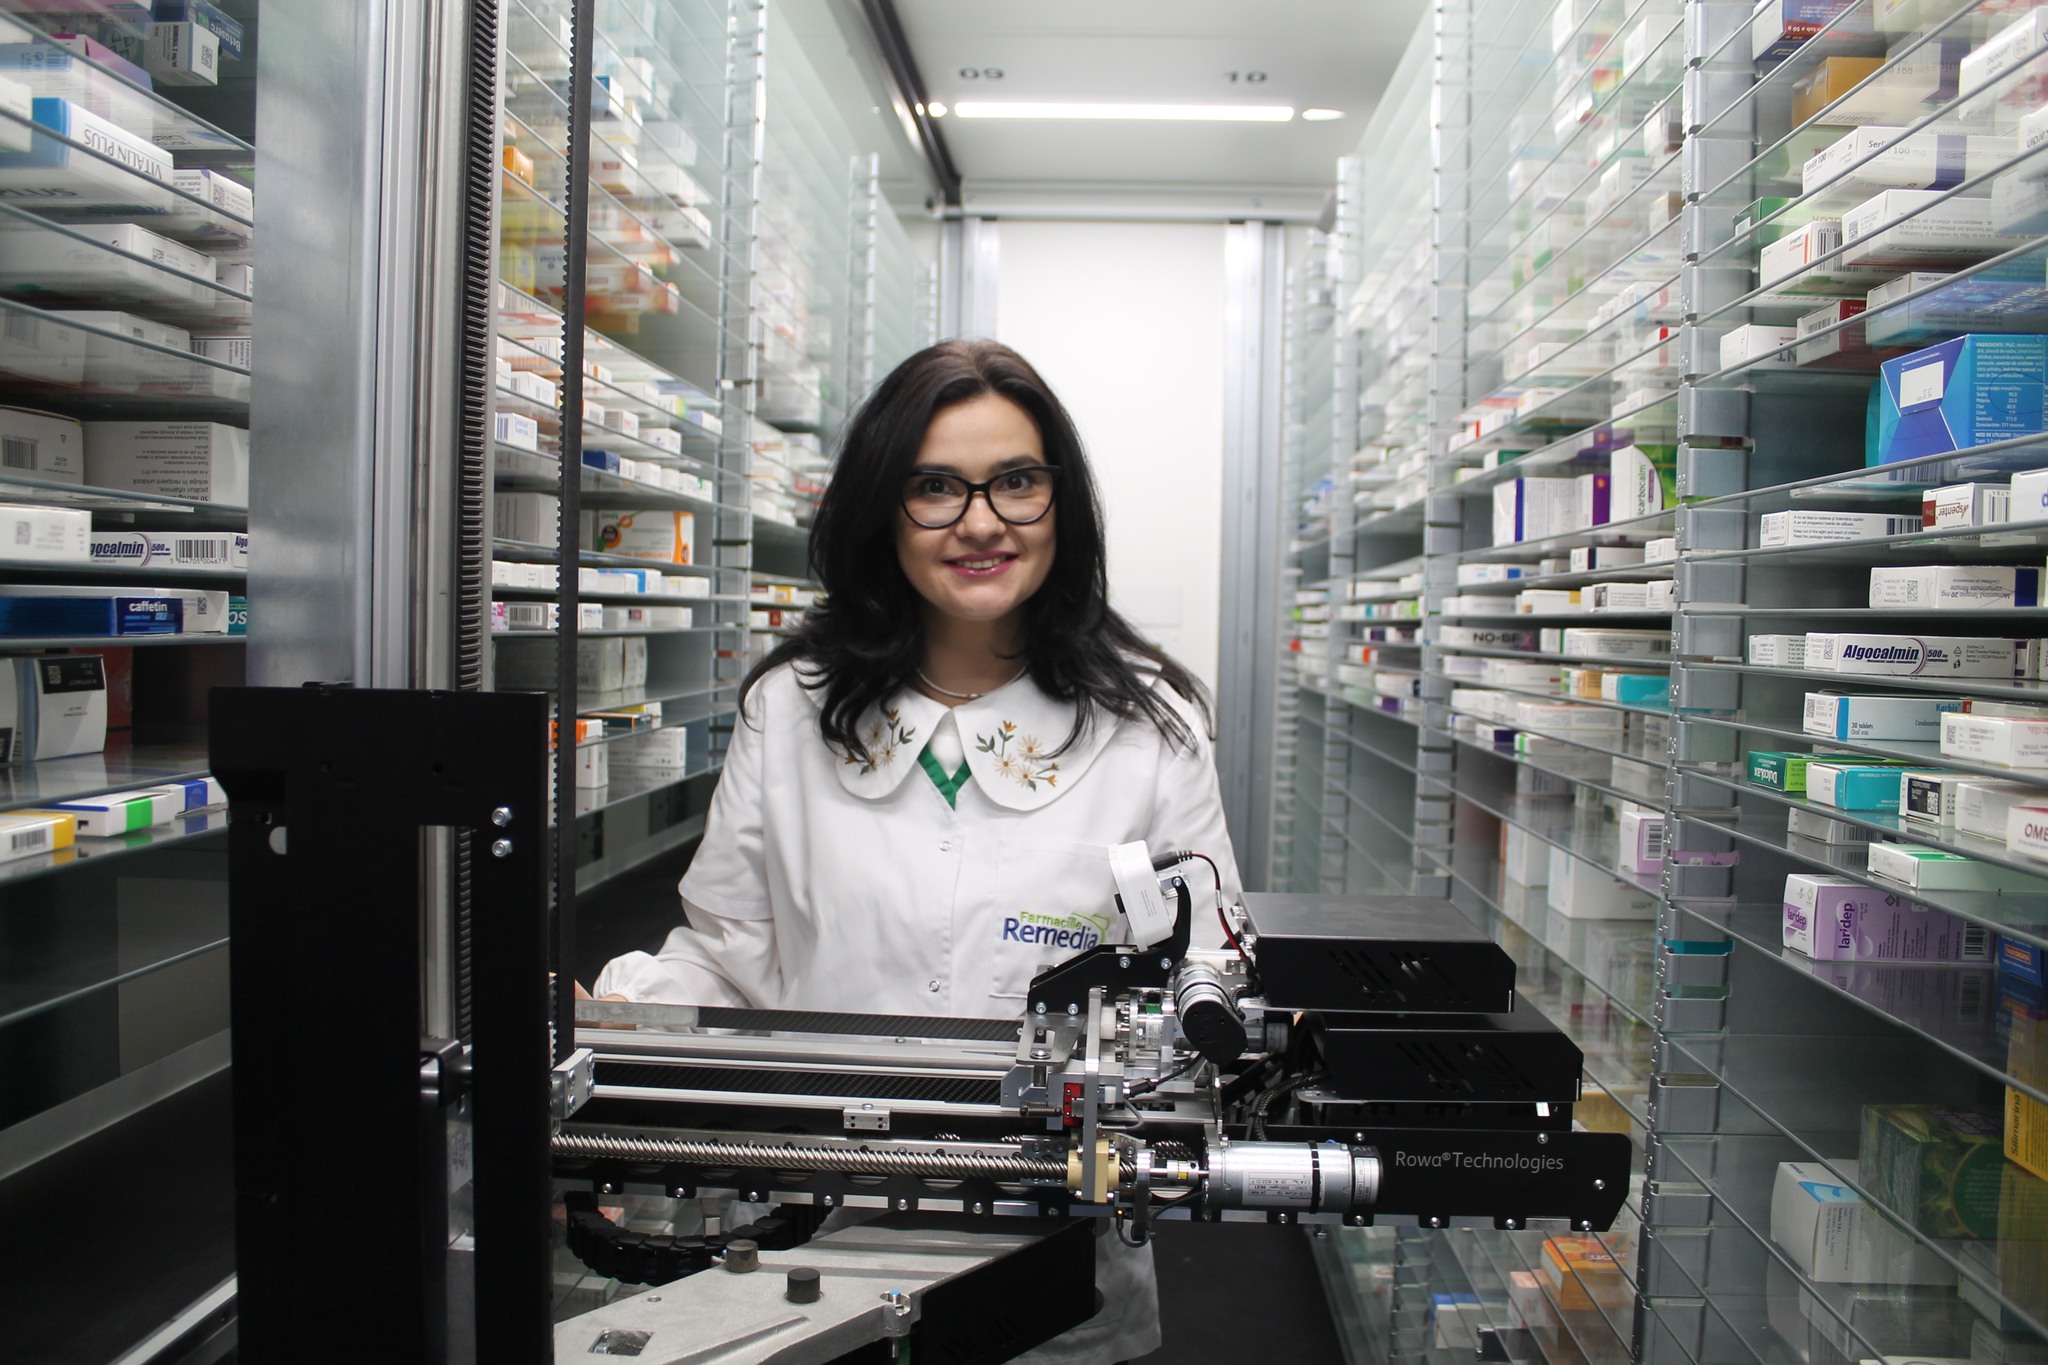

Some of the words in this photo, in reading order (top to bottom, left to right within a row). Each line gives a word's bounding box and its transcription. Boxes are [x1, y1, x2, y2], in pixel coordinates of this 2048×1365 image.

[83, 127, 116, 157] PLUS
[117, 146, 163, 181] VITALIN
[129, 600, 168, 612] caffetin
[1843, 644, 1919, 660] Algocalmin
[1928, 650, 1942, 658] 500
[1003, 917, 1098, 950] Remedia
[1021, 911, 1082, 930] Farmacille
[1838, 902, 1855, 949] laridep
[1453, 1151, 1564, 1175] Technologies
